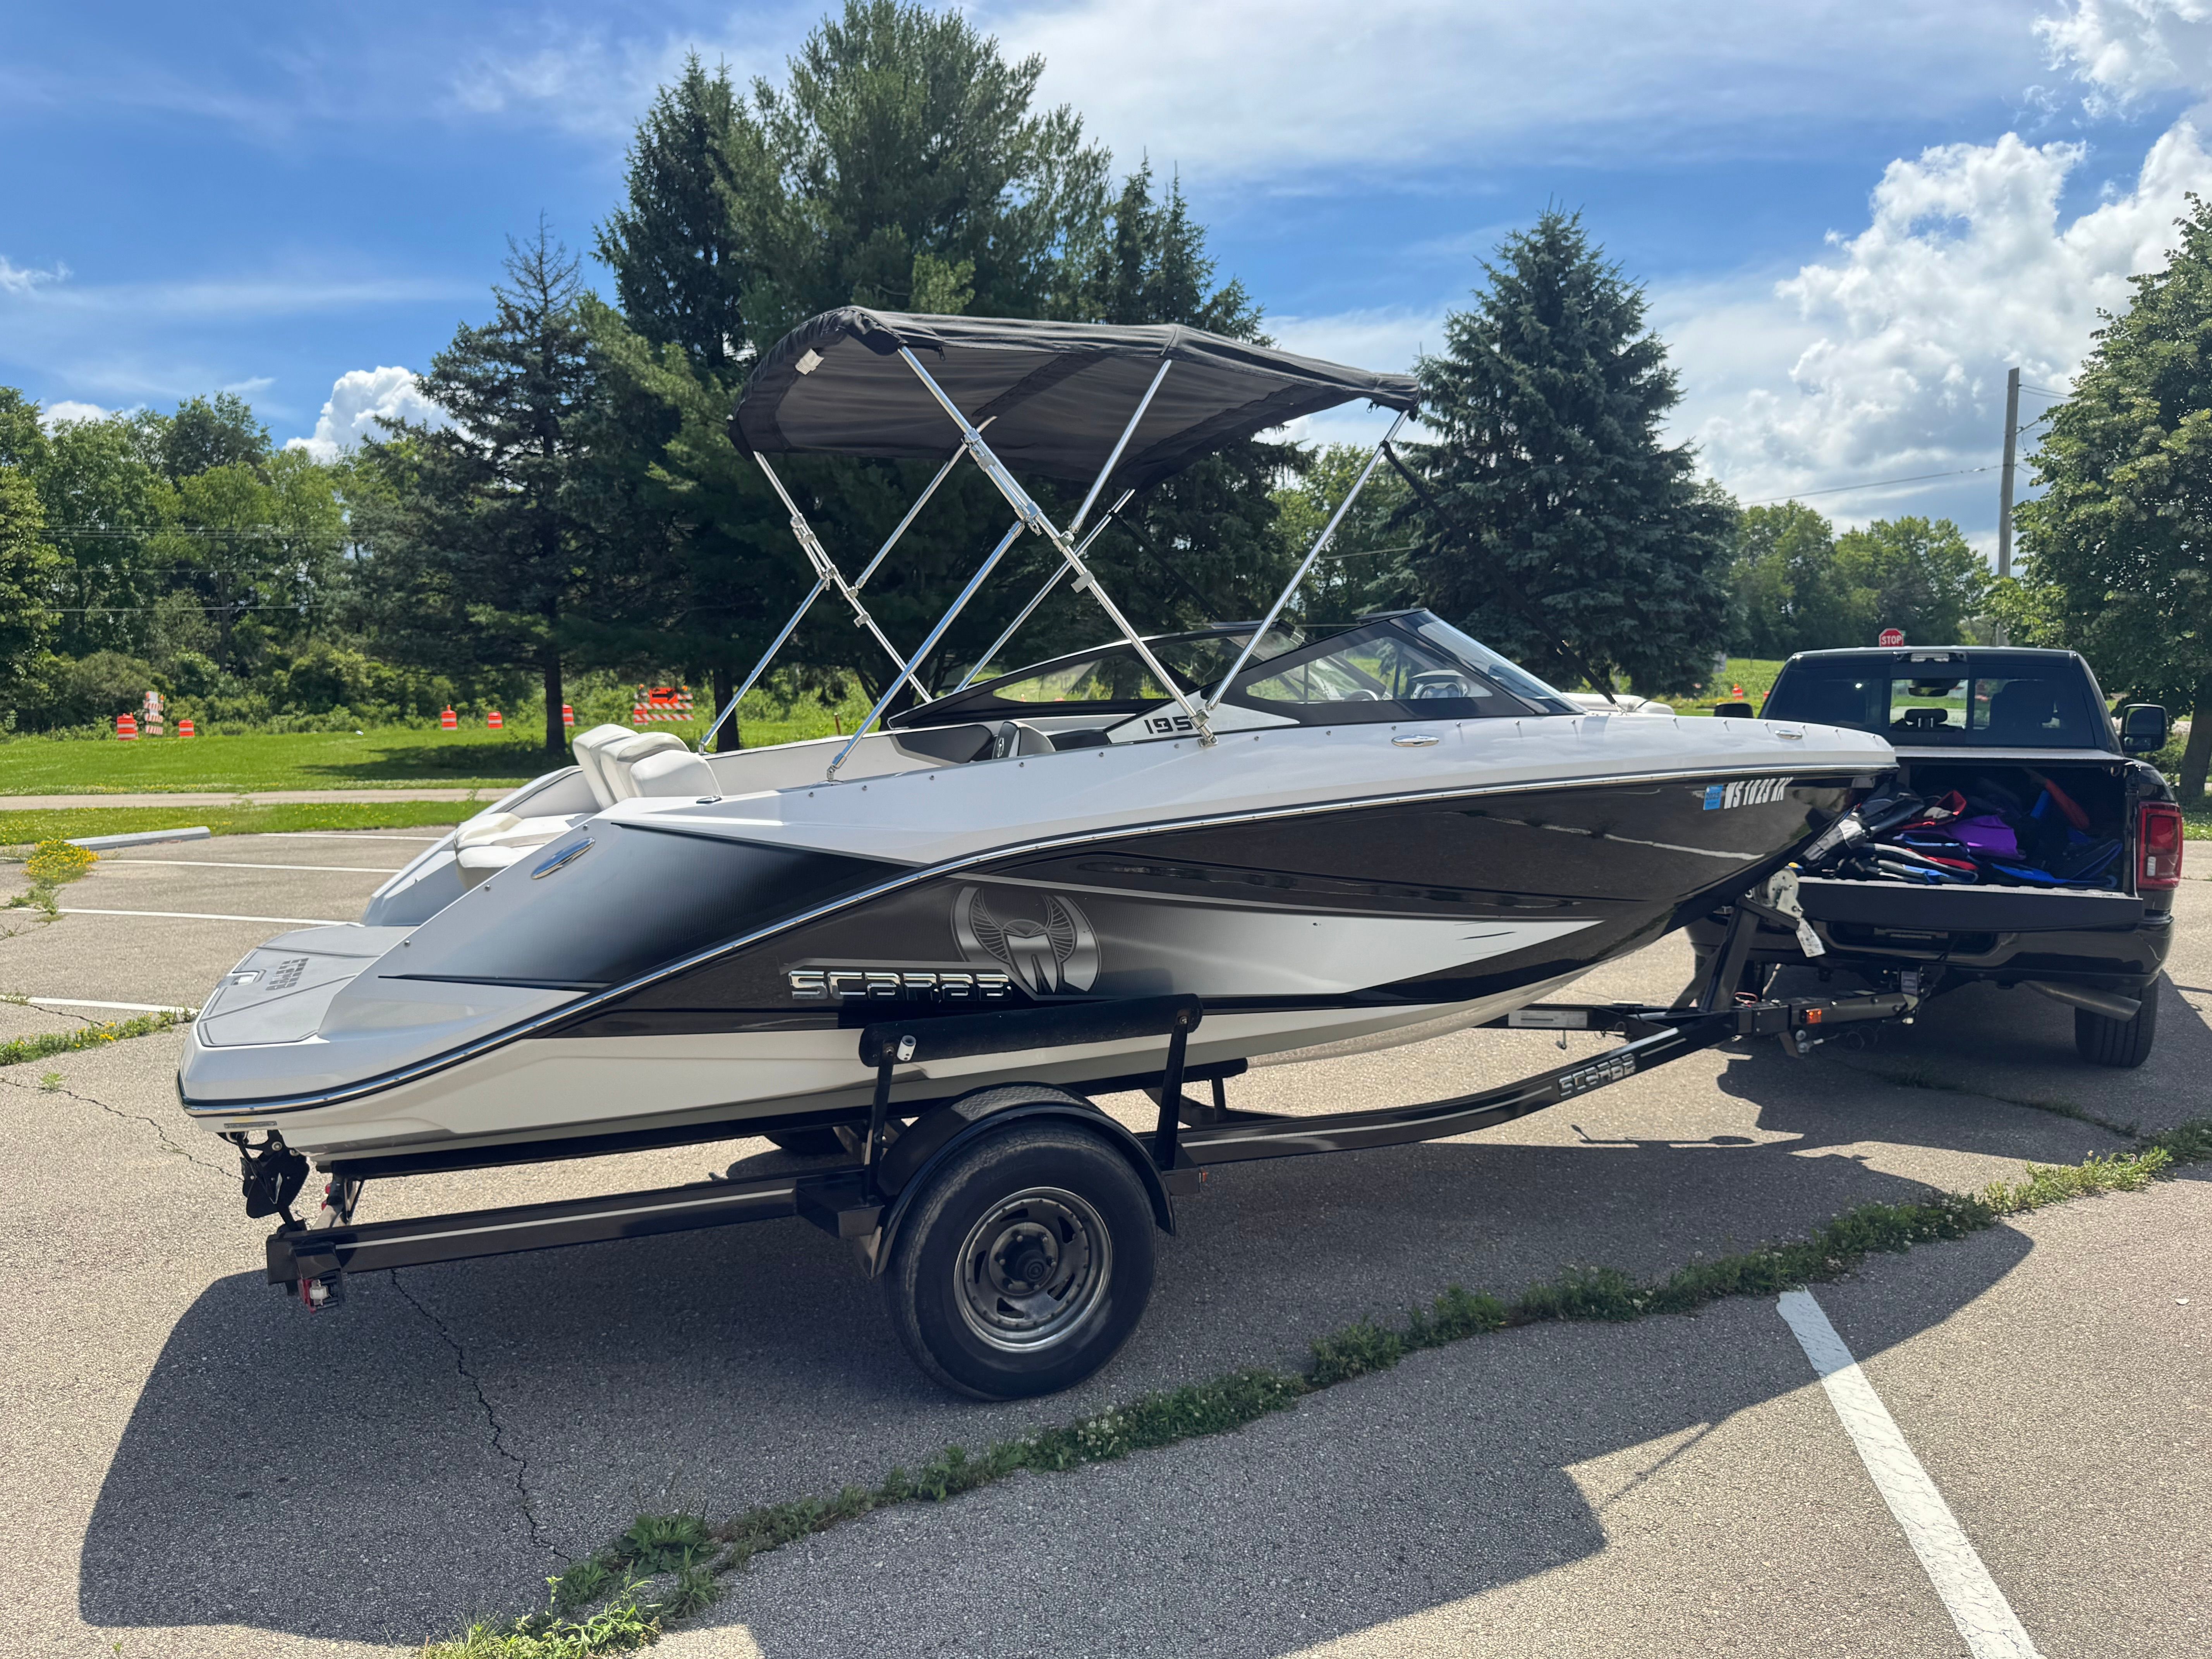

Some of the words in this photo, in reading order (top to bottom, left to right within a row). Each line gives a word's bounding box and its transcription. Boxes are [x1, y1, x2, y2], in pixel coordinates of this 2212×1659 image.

[1881, 635, 1902, 645] STOP
[1144, 715, 1193, 734] 195
[1724, 781, 1745, 809] WS
[1742, 778, 1776, 805] 1023
